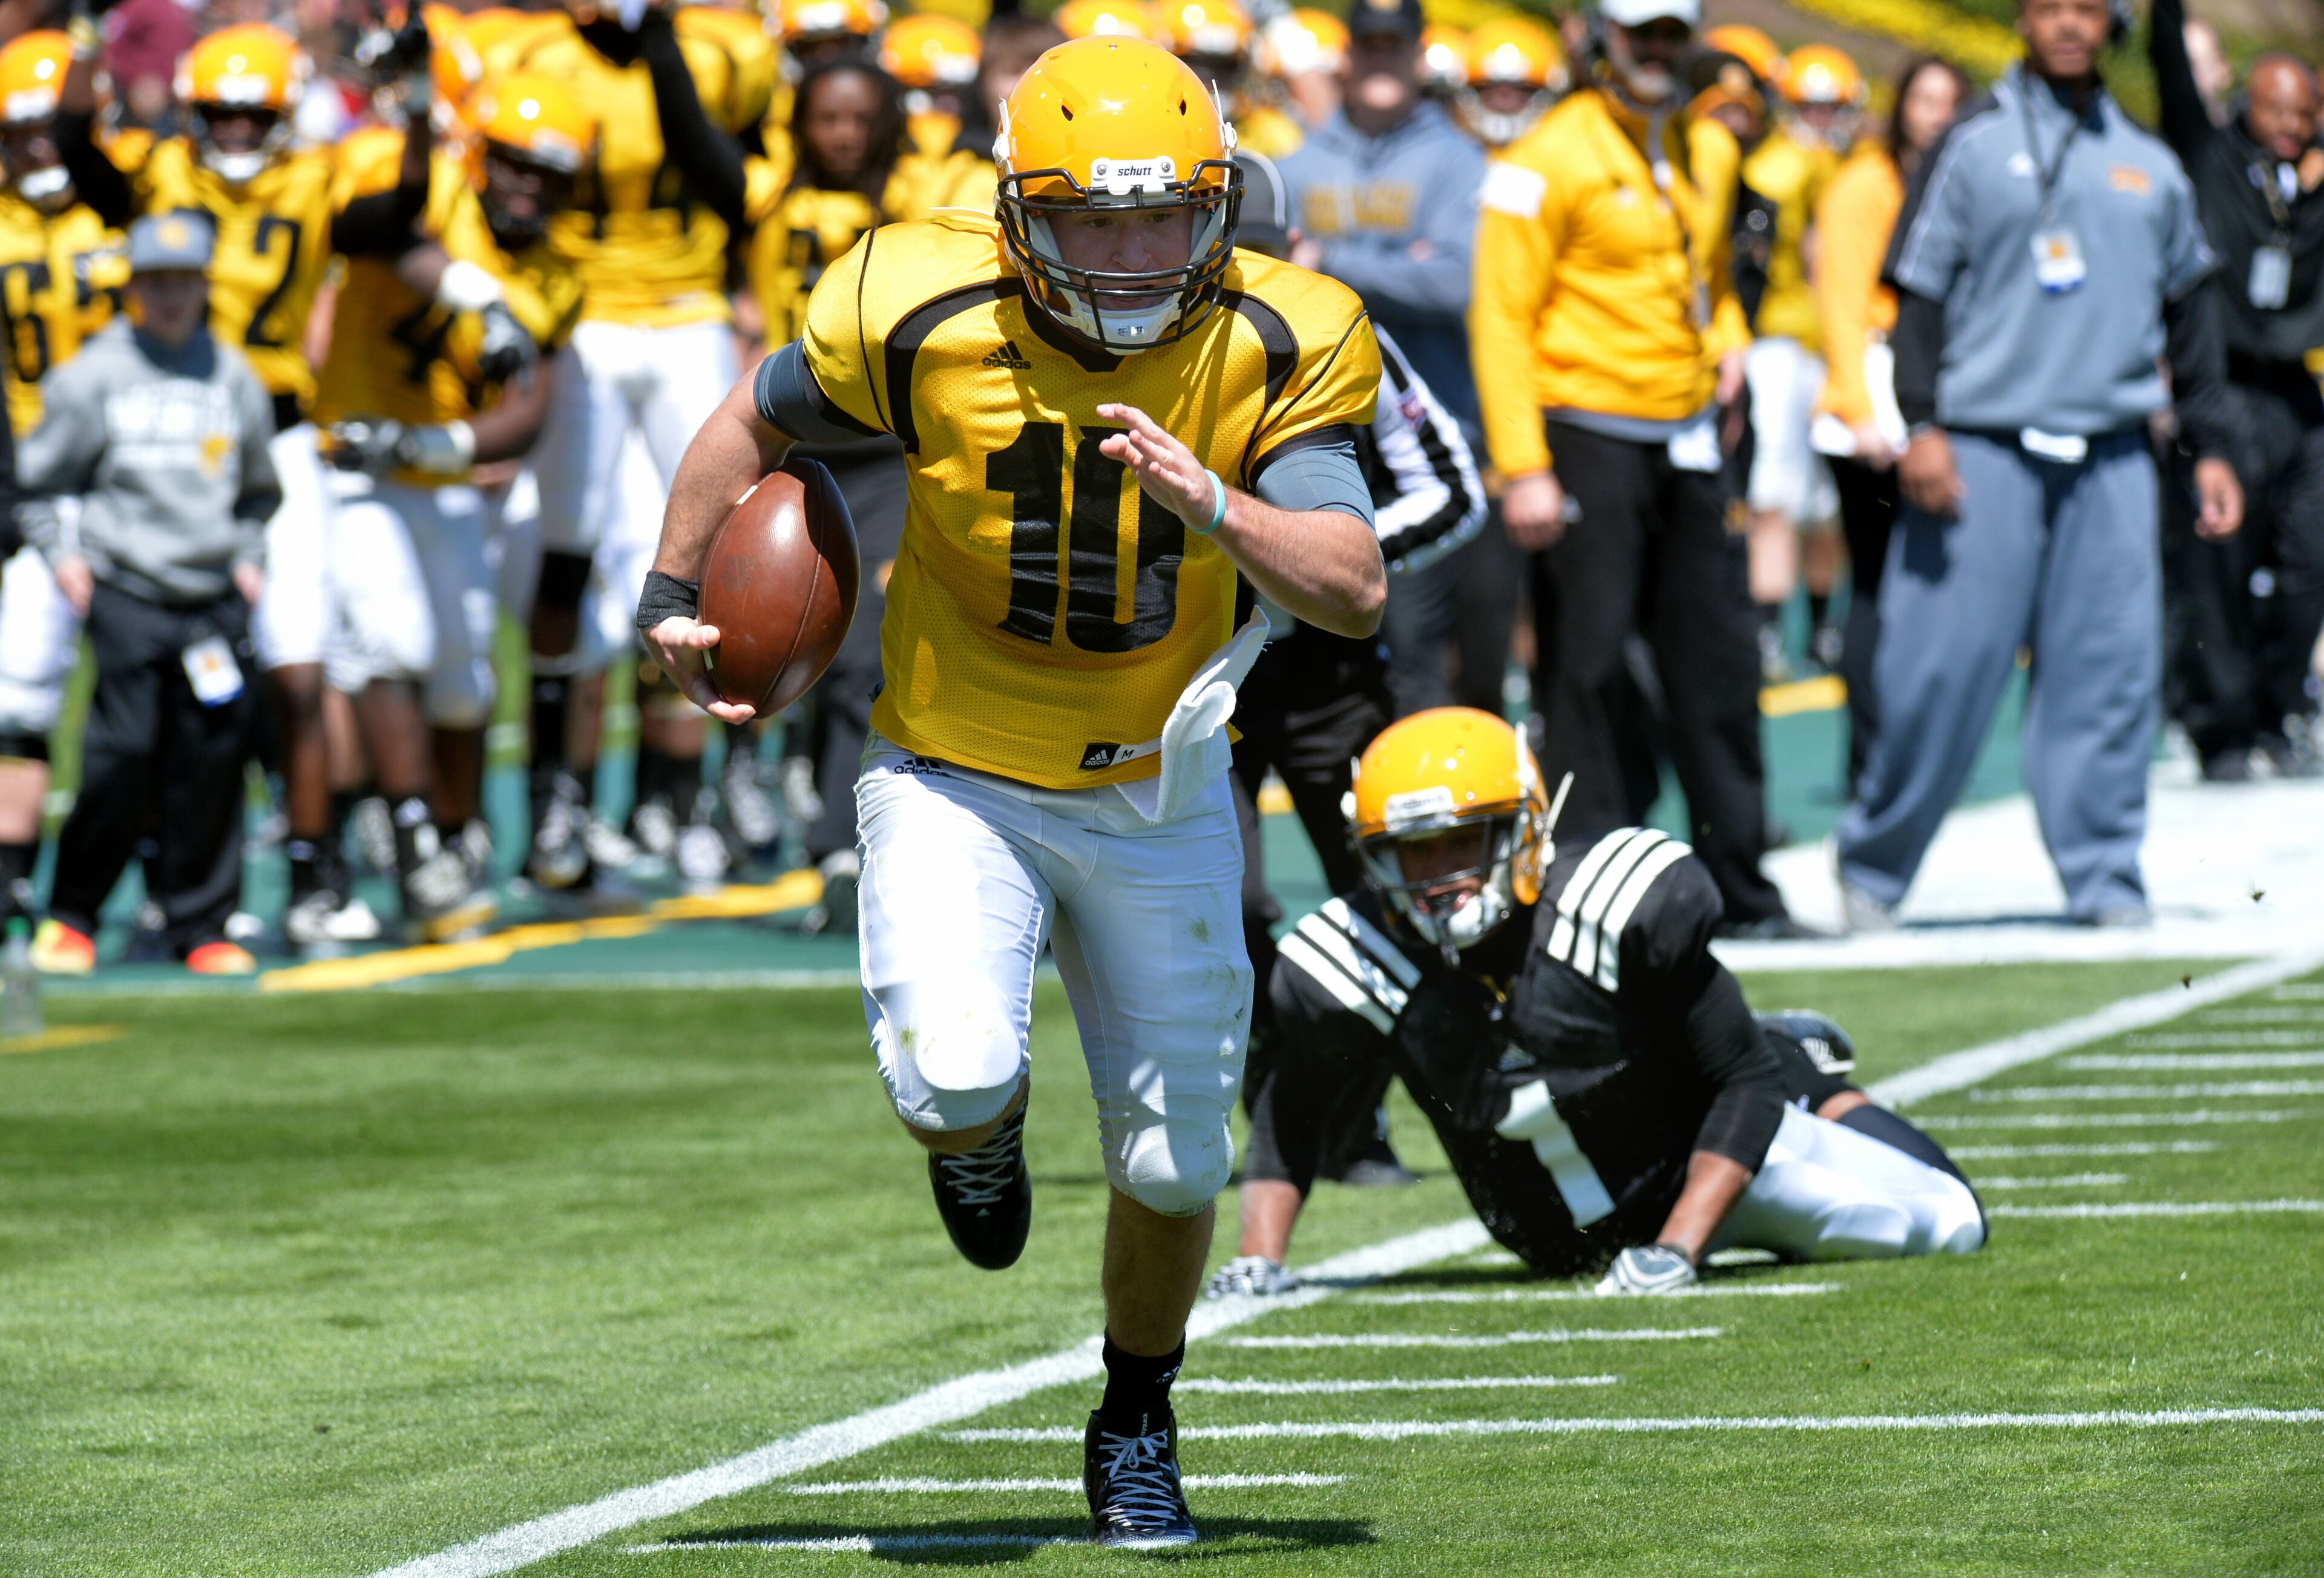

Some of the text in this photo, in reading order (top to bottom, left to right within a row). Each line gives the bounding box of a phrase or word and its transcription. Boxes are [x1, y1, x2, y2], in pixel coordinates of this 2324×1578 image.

[1118, 166, 1152, 176] schutt
[1117, 326, 1143, 335] schtt
[982, 357, 1031, 370] adidas
[985, 421, 1185, 653] 10
[1121, 750, 1135, 759] M
[894, 764, 951, 778] adidas
[1494, 1079, 1616, 1229] 1
